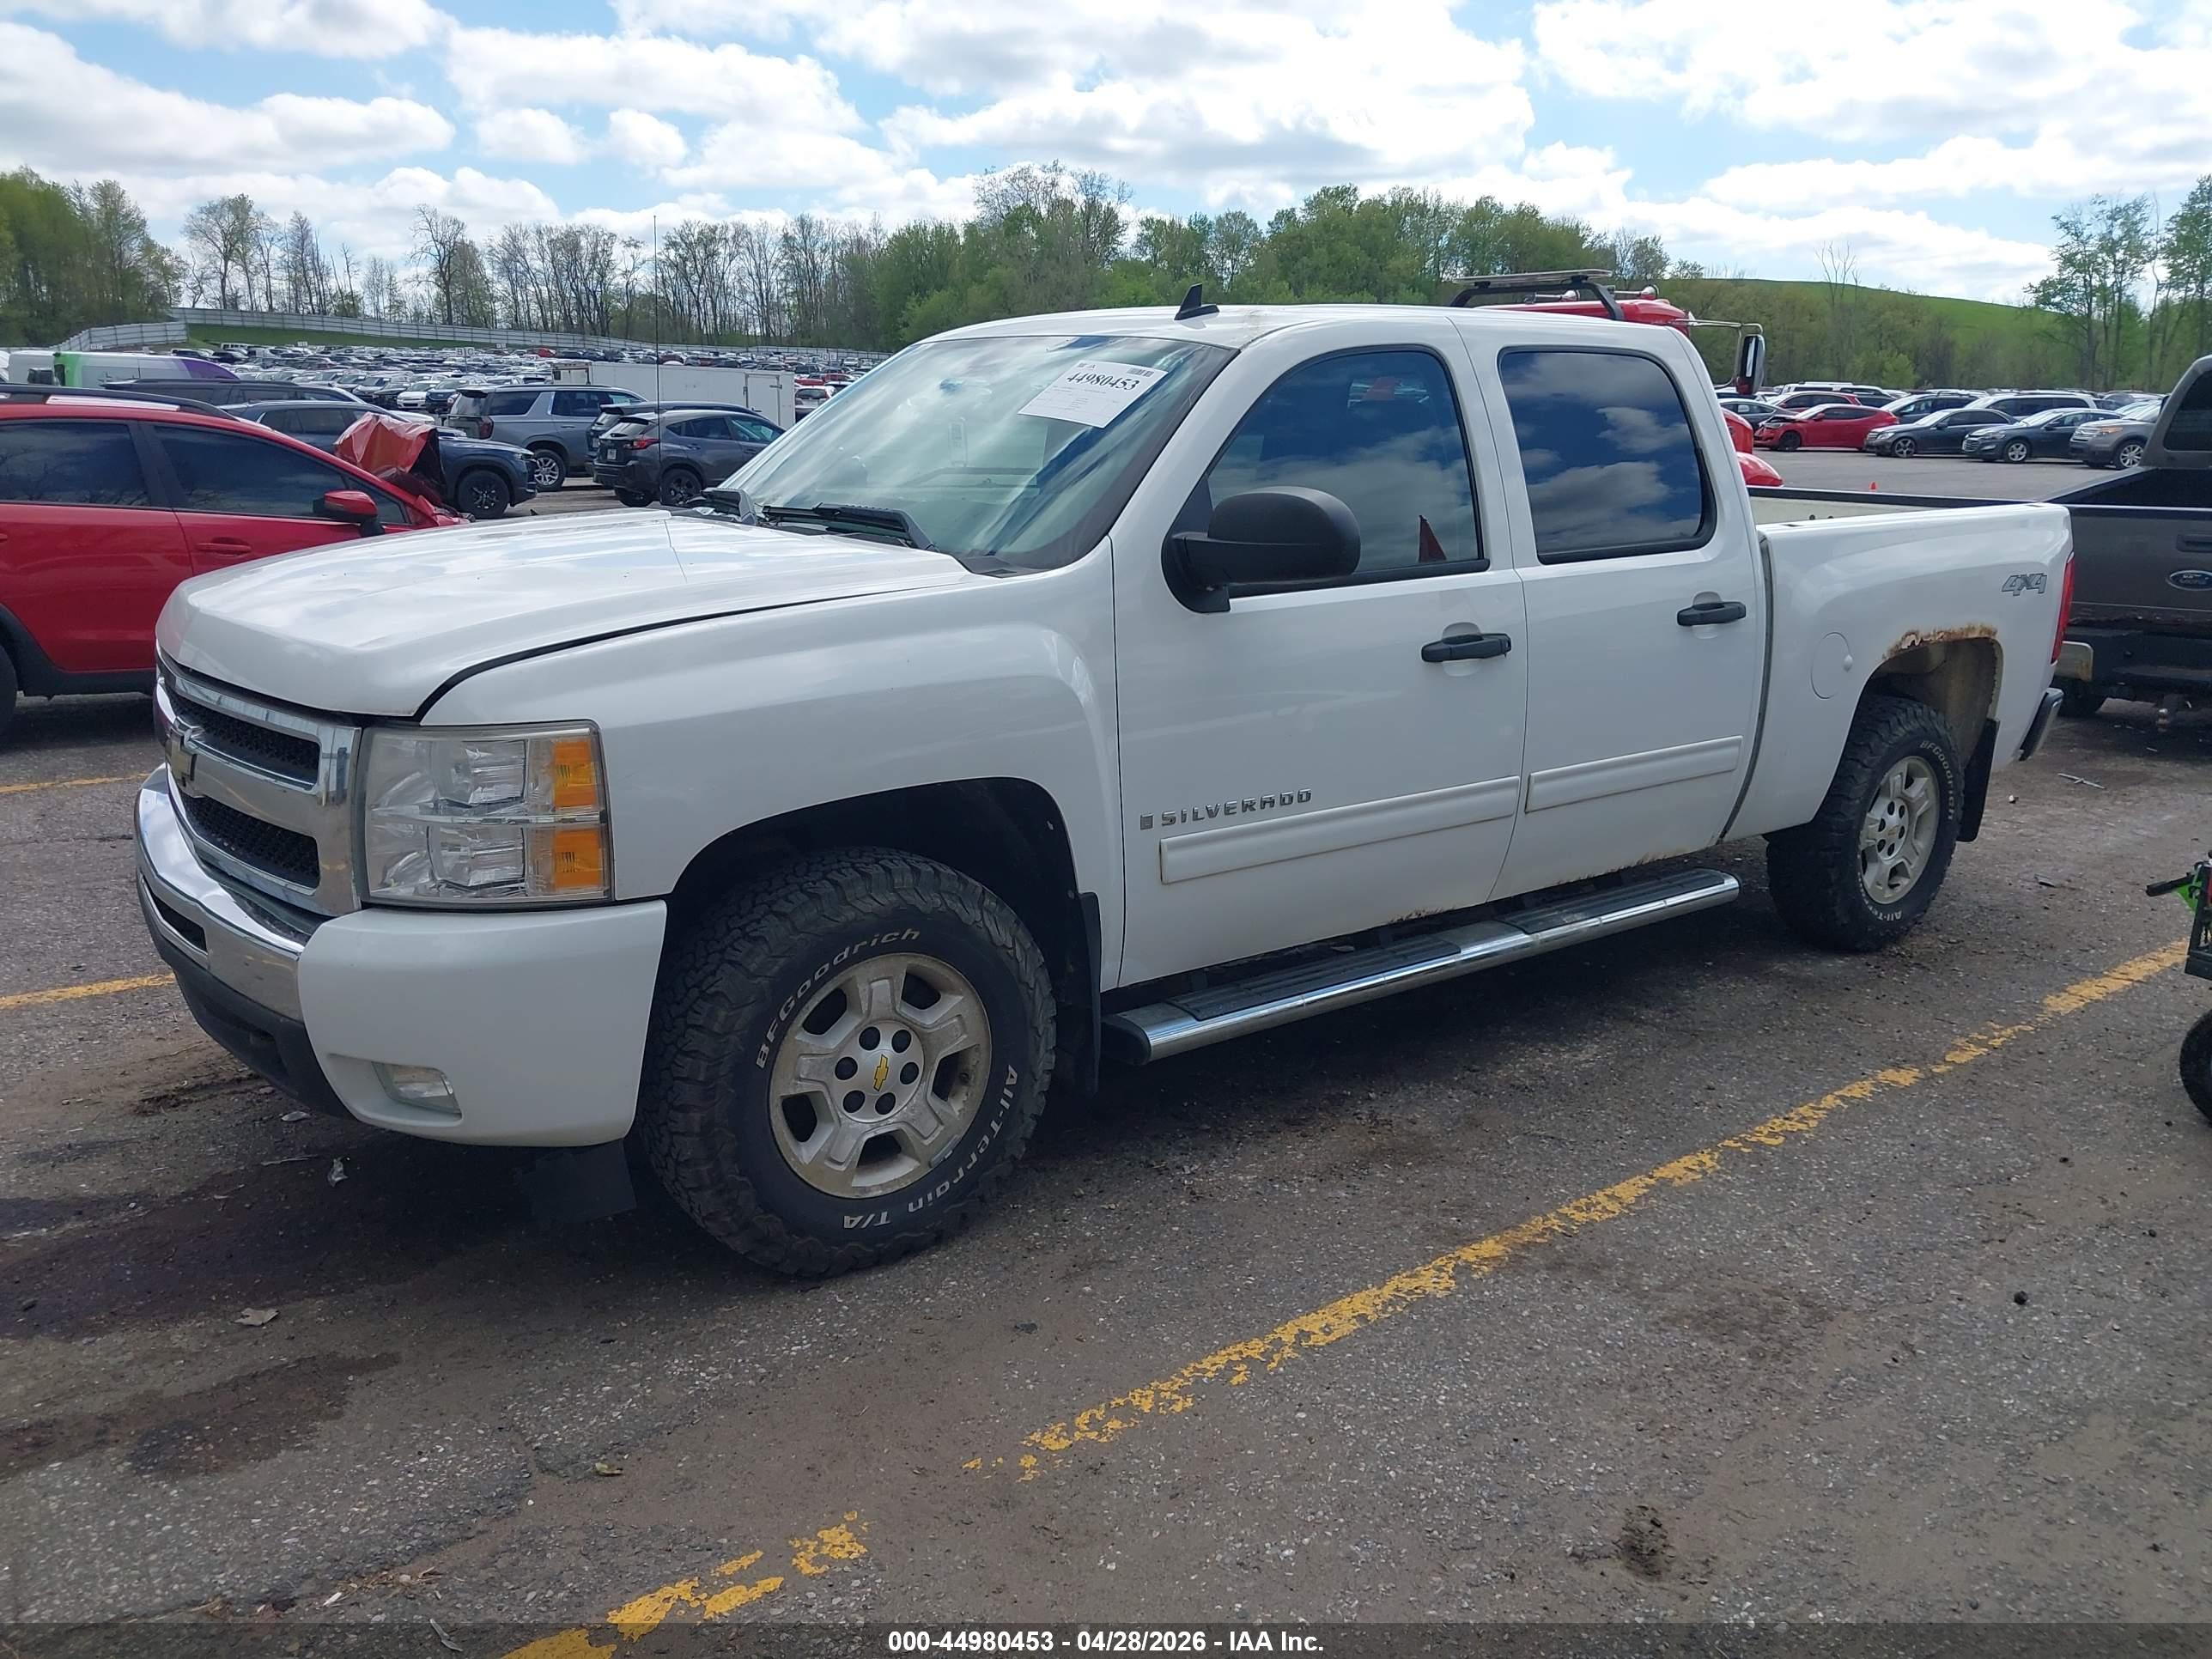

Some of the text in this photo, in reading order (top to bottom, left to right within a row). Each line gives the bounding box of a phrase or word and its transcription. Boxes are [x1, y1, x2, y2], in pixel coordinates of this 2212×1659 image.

[1066, 372, 1140, 390] 44980453
[1161, 788, 1312, 826] SILVERADO
[756, 928, 921, 1068] BFGoodrich
[843, 1065, 1018, 1229] All-Terrain T/A
